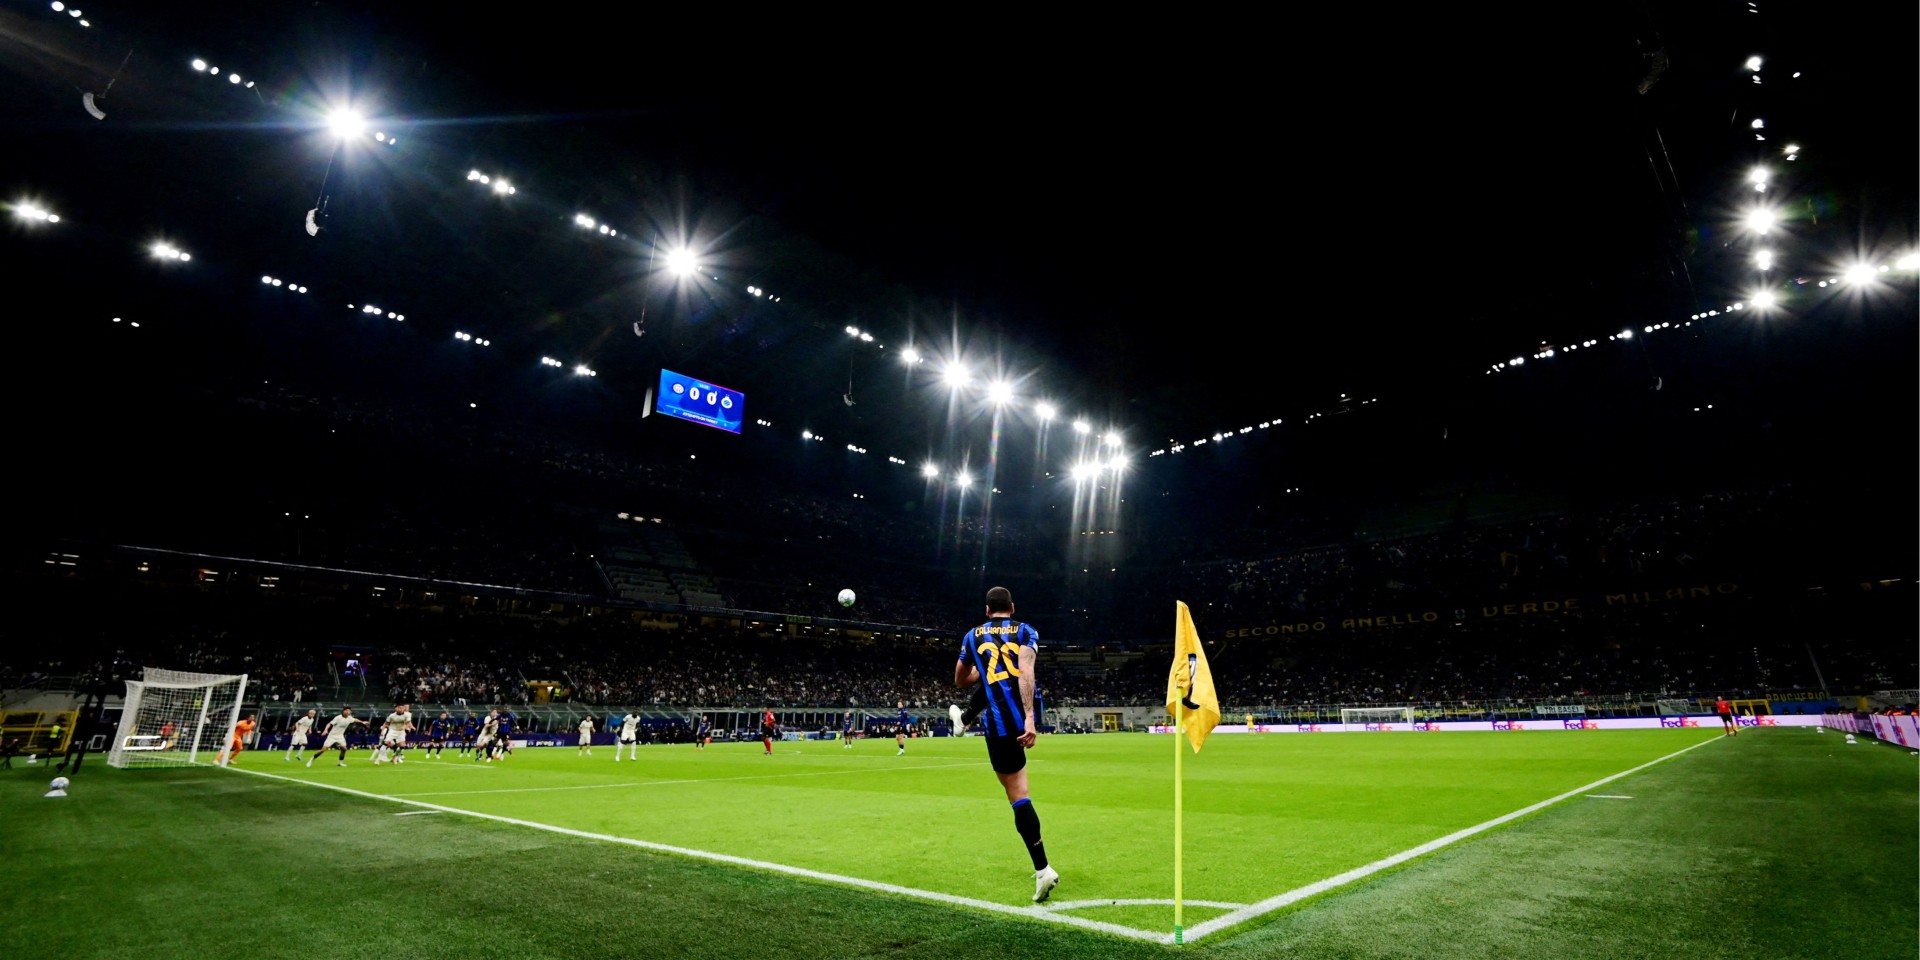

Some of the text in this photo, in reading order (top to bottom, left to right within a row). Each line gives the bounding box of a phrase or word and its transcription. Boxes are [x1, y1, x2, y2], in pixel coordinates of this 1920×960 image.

[690, 387, 700, 400] 0
[1225, 621, 1326, 638] SECONDO
[1341, 612, 1438, 630] ANELLO
[1605, 583, 1738, 605] MILANO
[977, 642, 1020, 685] 20
[1365, 722, 1392, 731] FedEx
[1492, 720, 1523, 731] FedEx
[1563, 719, 1598, 730] FedEx
[1660, 716, 1699, 728] FedEx
[1735, 715, 1776, 727] FedEx
[1298, 723, 1322, 733] FedEx
